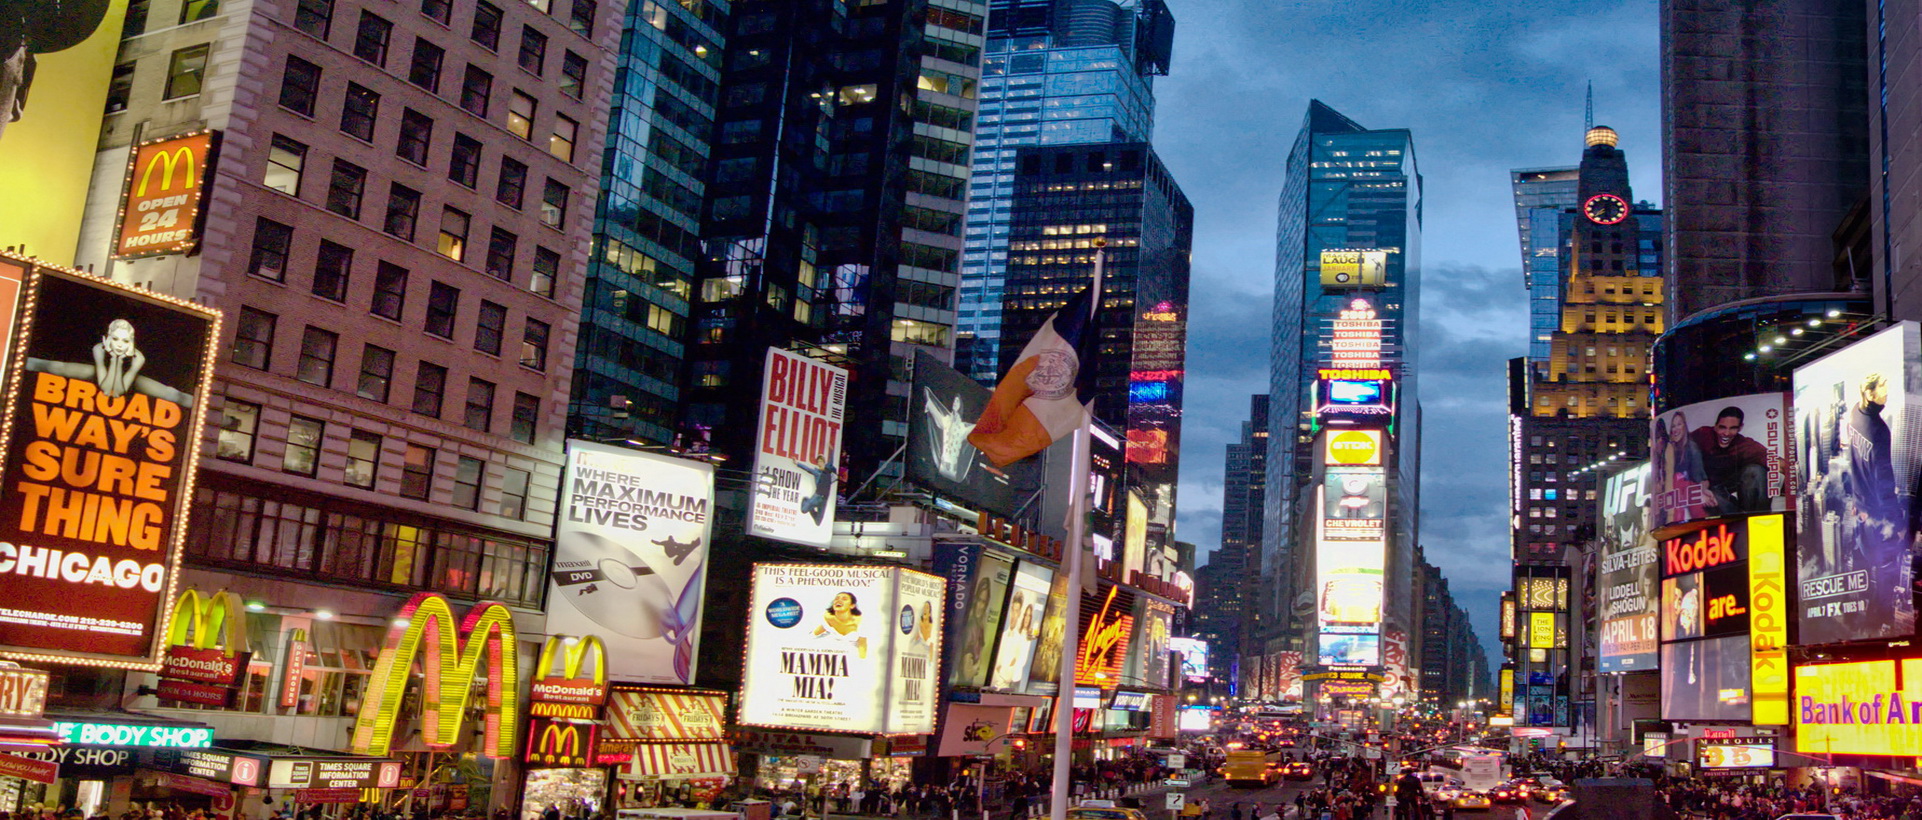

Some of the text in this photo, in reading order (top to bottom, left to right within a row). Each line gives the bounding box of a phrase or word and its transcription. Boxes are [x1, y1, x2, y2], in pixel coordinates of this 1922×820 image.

[137, 194, 188, 212] OPEN
[138, 209, 178, 232] 24
[125, 229, 188, 248] HOURS
[1340, 310, 1376, 320] 2009
[768, 352, 834, 416] BILLY
[1318, 369, 1392, 380] TOSHIBA
[34, 372, 182, 429] BROAD
[831, 373, 846, 420] THE MUSICAL
[32, 402, 177, 462] WAY'S
[762, 404, 840, 465] ELLIOT
[22, 440, 172, 502] SURE
[1767, 422, 1780, 498] SOUTHPOLE
[576, 466, 640, 488] WHERE
[772, 467, 802, 490] SHOW
[573, 478, 706, 513] MAXIMUM
[782, 490, 800, 503] YEAR
[1603, 462, 1652, 518] UFC
[18, 482, 164, 551] THING
[568, 505, 648, 532] LIVES
[571, 494, 705, 524] PERFORMANCE
[1326, 520, 1382, 528] CHEVROLET
[1602, 548, 1658, 574] SILVA-LEITES
[1666, 524, 1737, 576] Kodak
[0, 542, 164, 592] CHICAGO
[556, 560, 592, 569] maxell
[788, 568, 844, 578] FEEL-GOOD
[847, 570, 891, 578] MUSICAL
[570, 571, 592, 582] DVD
[775, 576, 784, 584] IS
[955, 546, 969, 610] VORNADO
[1803, 573, 1864, 597] RESCUE ME
[1610, 582, 1640, 600] LIDDELL
[1708, 594, 1746, 620] are...
[1807, 606, 1822, 618] APRIL
[1827, 602, 1842, 618] FX
[1843, 601, 1856, 614] TUES
[1534, 626, 1552, 634] LION
[1602, 616, 1656, 644] APRIL 18
[1753, 572, 1783, 670] Kodak
[1080, 584, 1127, 684] Virgin
[1533, 634, 1552, 642] KING
[164, 656, 232, 674] McDonald's
[294, 644, 302, 668] OPEN
[780, 652, 849, 677] MAMMA
[900, 656, 926, 679] MAMMA
[170, 668, 218, 679] Restaurant
[160, 686, 222, 700] OPEN 24 HOURS
[288, 675, 298, 704] HOURS
[533, 684, 602, 696] McDonald's
[543, 693, 590, 702] Restaurant
[792, 676, 834, 700] MIA!
[905, 680, 920, 700] MIA!
[1154, 698, 1164, 737] BIENVENIDOS
[1801, 694, 1855, 724] Bank
[1859, 694, 1882, 724] of
[80, 724, 148, 745] BODY
[74, 748, 129, 766] SHOP
[181, 749, 230, 764] TIMES SQUARE
[600, 743, 635, 752] ameras
[180, 758, 227, 772] INFORMATION
[188, 766, 216, 777] CENTER
[344, 763, 372, 771] SQUARE
[329, 780, 358, 788] CENTER
